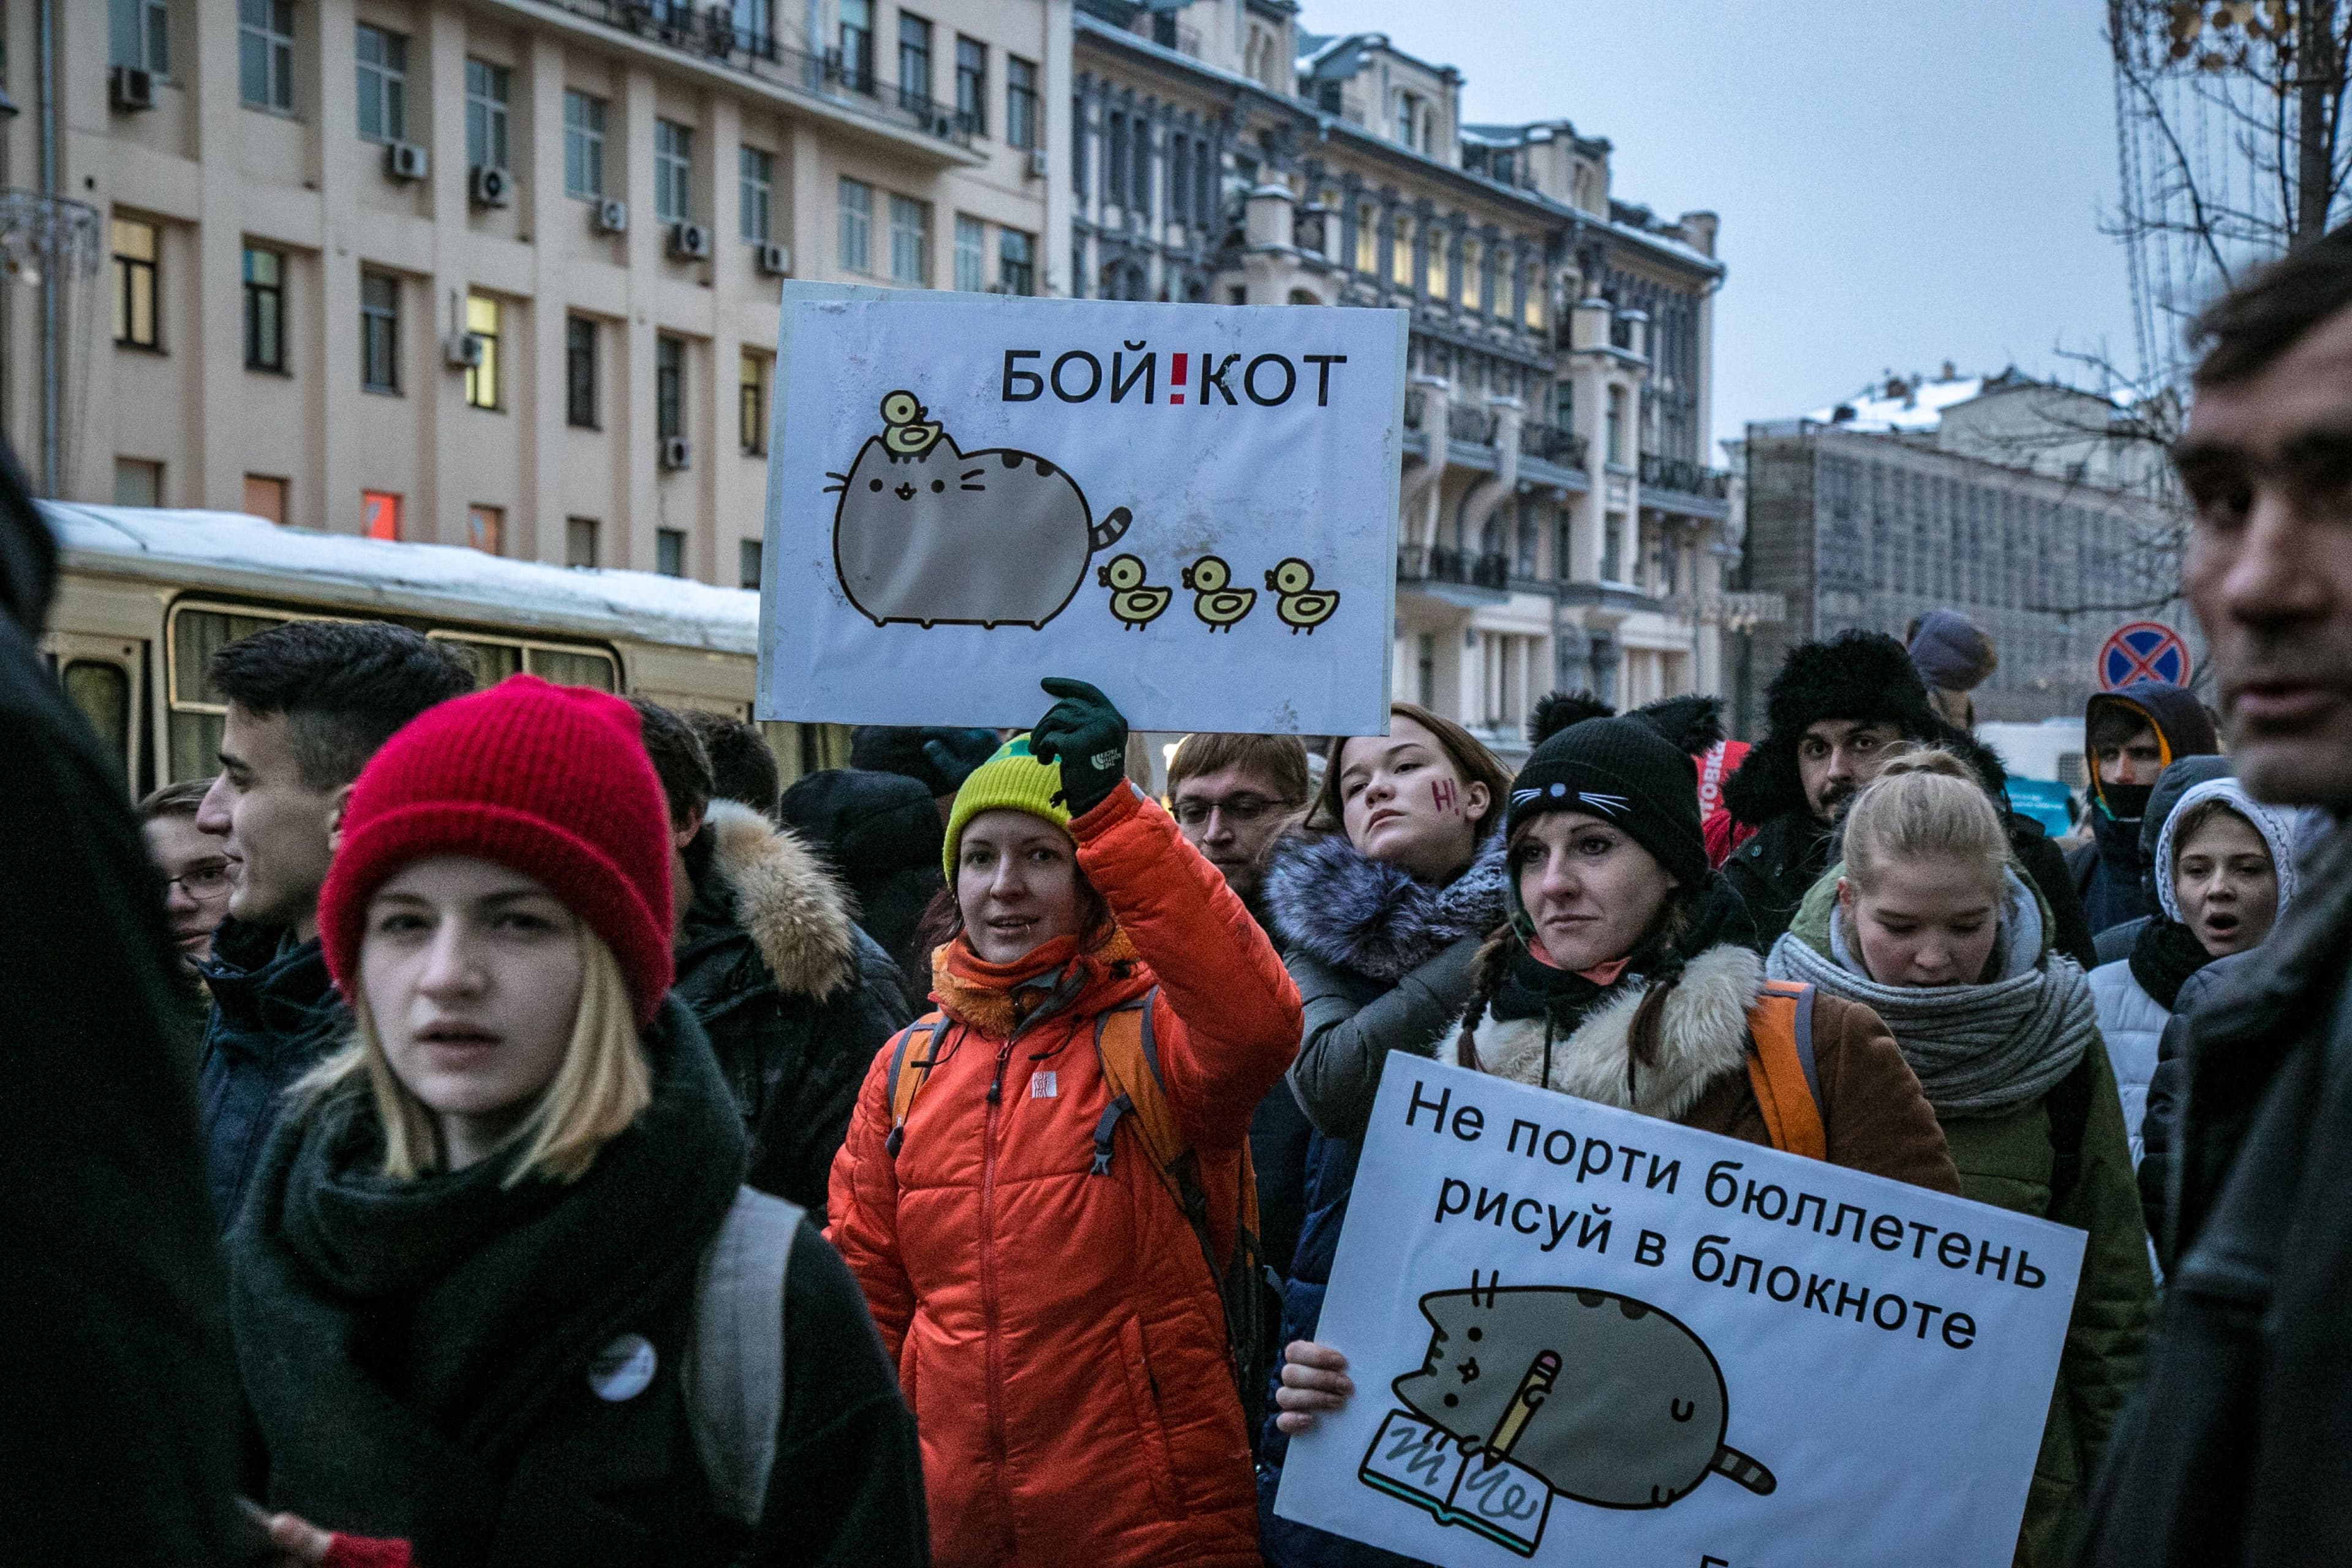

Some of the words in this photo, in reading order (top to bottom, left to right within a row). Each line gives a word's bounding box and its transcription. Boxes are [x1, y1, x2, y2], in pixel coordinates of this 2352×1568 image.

[1001, 339, 1348, 407] БОЙ!КОТ
[1698, 739, 1727, 821] ТОВКА
[1405, 1080, 1485, 1142] Не
[1506, 1118, 1682, 1195] порти
[1705, 1159, 2047, 1289] бюллетень
[1434, 1177, 1613, 1254] рисуй
[1634, 1228, 1667, 1268] в
[1691, 1234, 1977, 1351] блокноте
